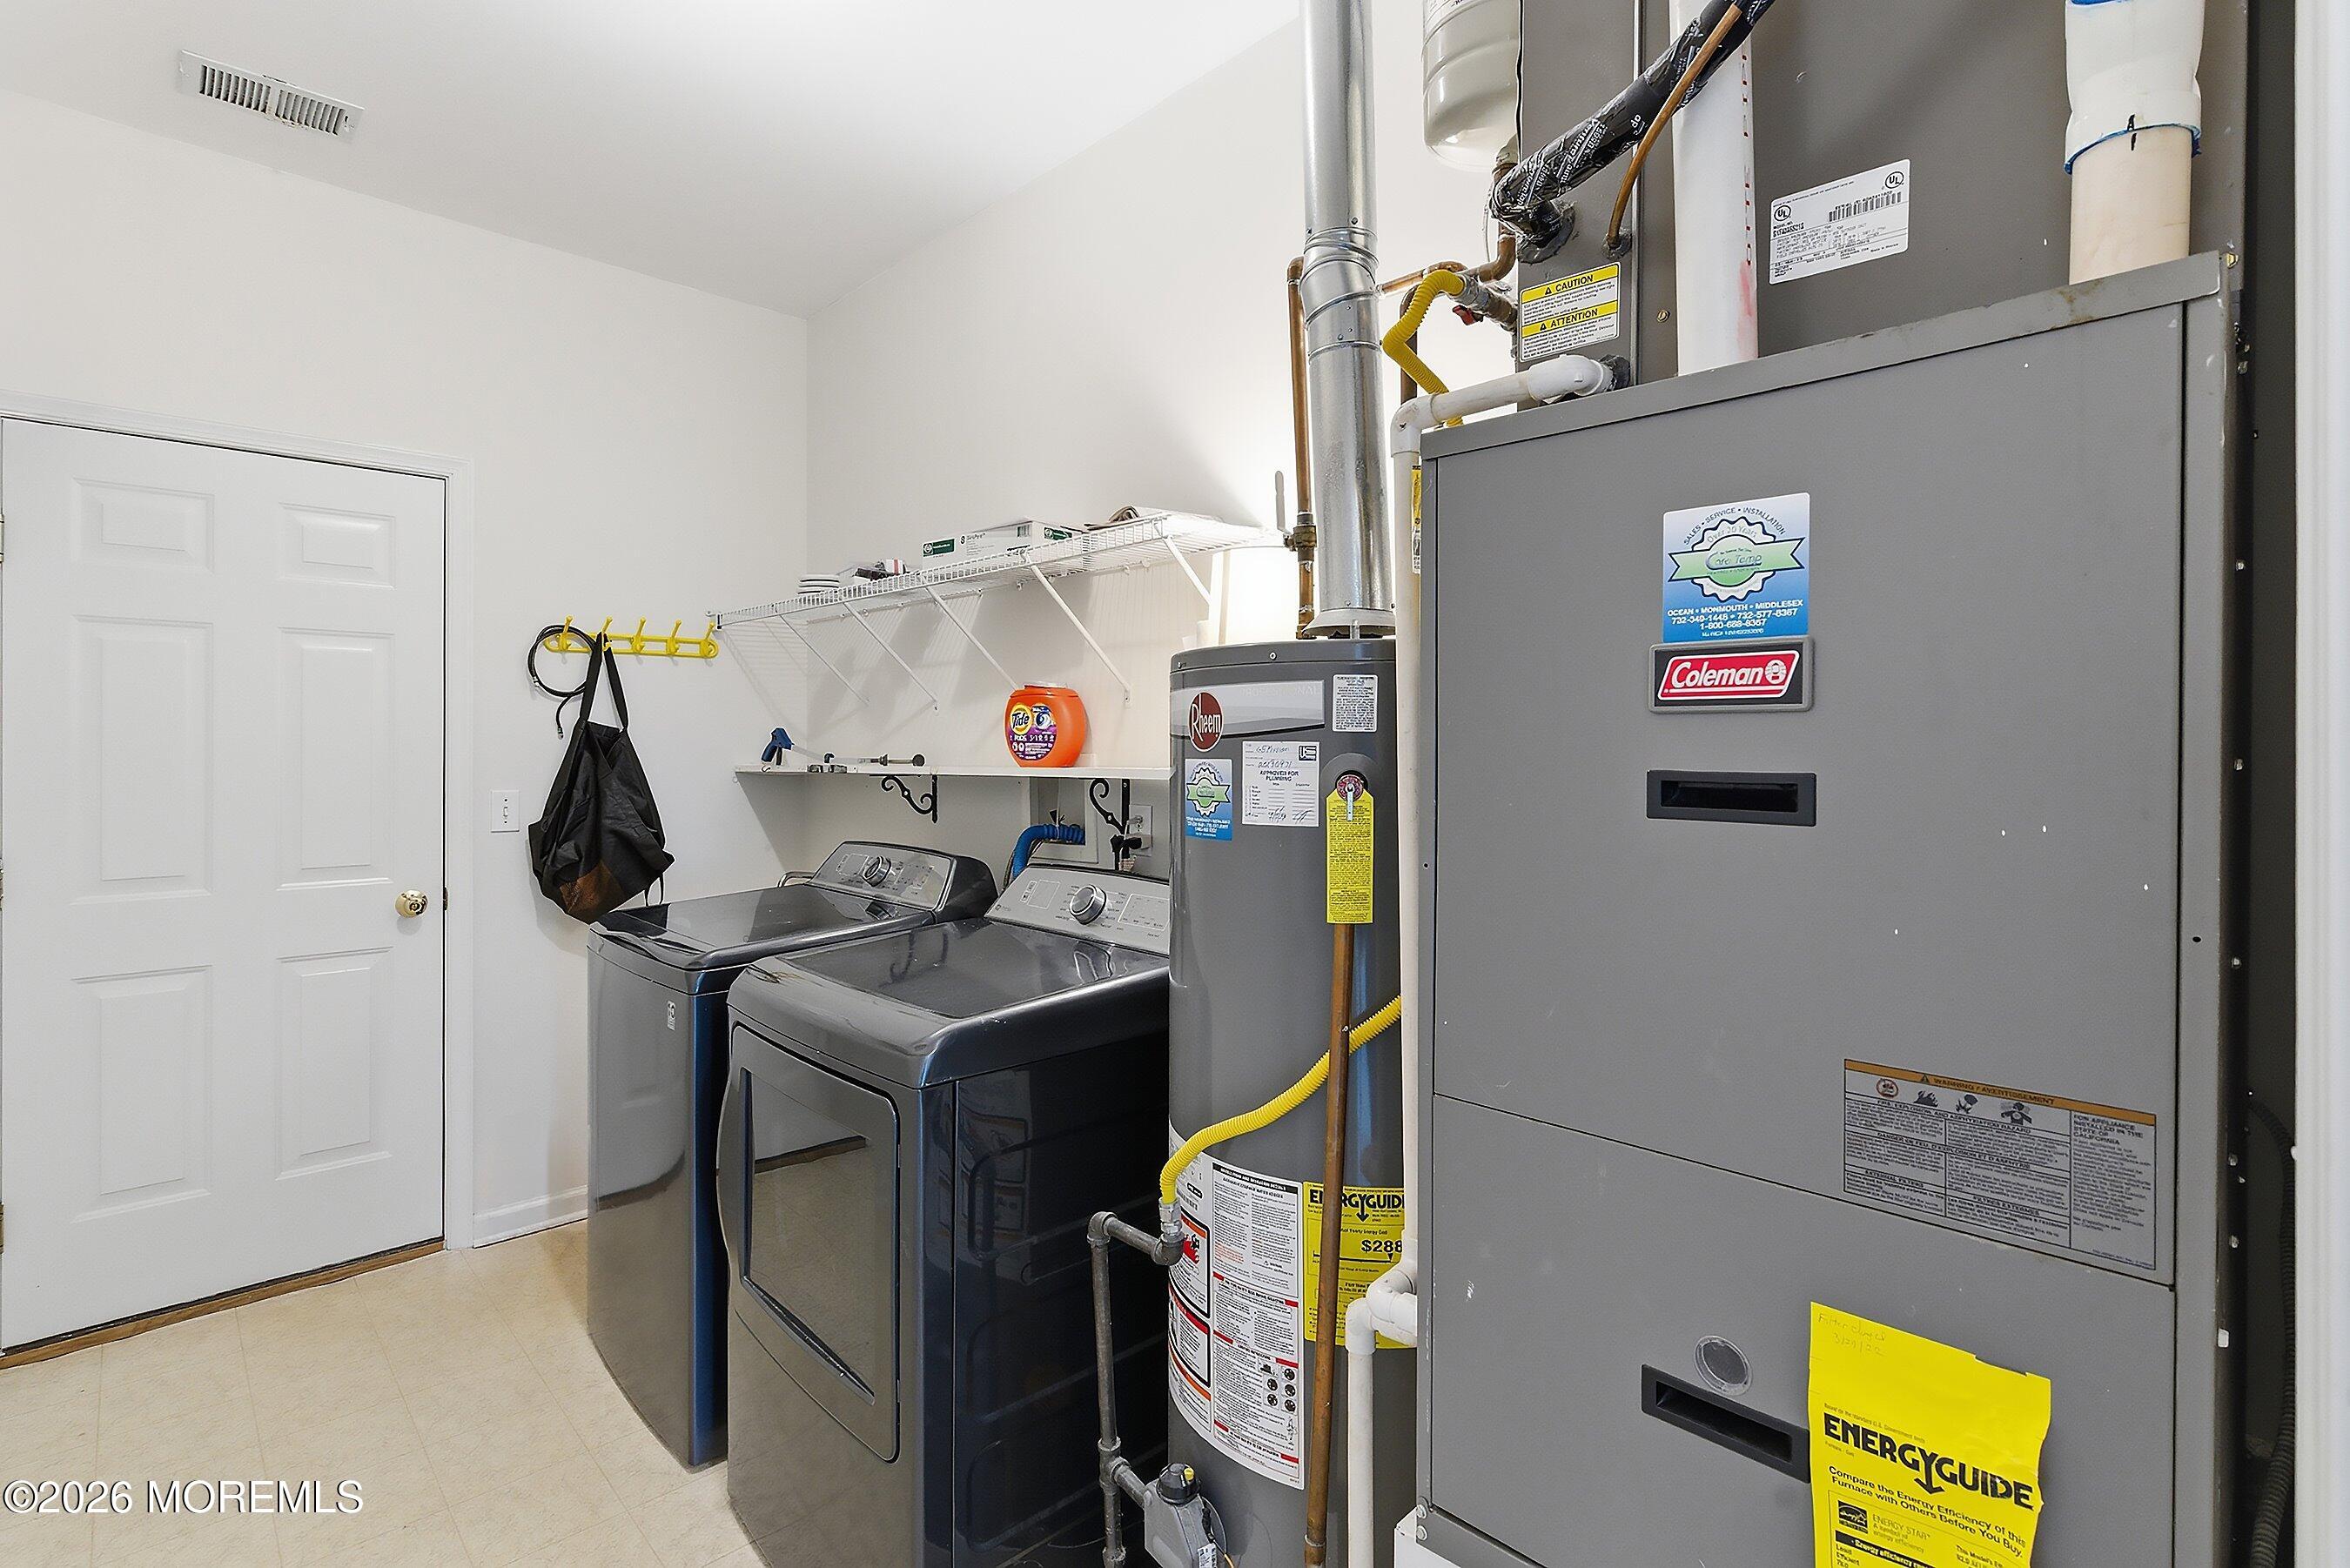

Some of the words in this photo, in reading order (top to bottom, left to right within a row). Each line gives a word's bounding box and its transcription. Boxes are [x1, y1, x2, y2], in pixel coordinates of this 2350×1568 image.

[1888, 175, 1899, 184] UL
[1777, 208, 1787, 218] UL
[1555, 275, 1593, 291] CAUTION
[1551, 309, 1598, 327] ATTENTION
[1683, 526, 1702, 545] SALES
[1705, 507, 1736, 523] SERVICE
[1742, 507, 1786, 535] INSTALLATION
[1707, 528, 1725, 543] Over
[1738, 526, 1757, 538] Years
[1667, 608, 1694, 617] OCEAN
[1701, 604, 1748, 614] MONMOUTH
[1755, 600, 1803, 610] MIDDLESEX
[1671, 661, 1762, 688] Coleman
[1012, 712, 1030, 729] Tide
[1192, 694, 1221, 741] Rheem
[1934, 1078, 1974, 1091] WARNING
[2073, 1131, 2120, 1145] CALIFORNIA
[1361, 1239, 1402, 1254] $288
[1824, 1412, 2034, 1511] ENERGYGUIDE
[1829, 1465, 1875, 1488] Compare
[1877, 1484, 1894, 1495] the
[1897, 1491, 1934, 1511] Energy
[1937, 1504, 1991, 1530] Efficiency
[1995, 1524, 2005, 1535] of
[2008, 1531, 2025, 1548] this
[1832, 1476, 1872, 1497] Furnace
[1876, 1492, 1897, 1505] with
[1901, 1501, 1937, 1519] Others
[1939, 1514, 1976, 1534] Before
[1979, 1527, 2000, 1544] You
[2003, 1538, 2023, 1558] Buy.
[1873, 1514, 1904, 1531] ENERGY
[1854, 1539, 1878, 1556] Energy
[1880, 1550, 1912, 1567] efficiency
